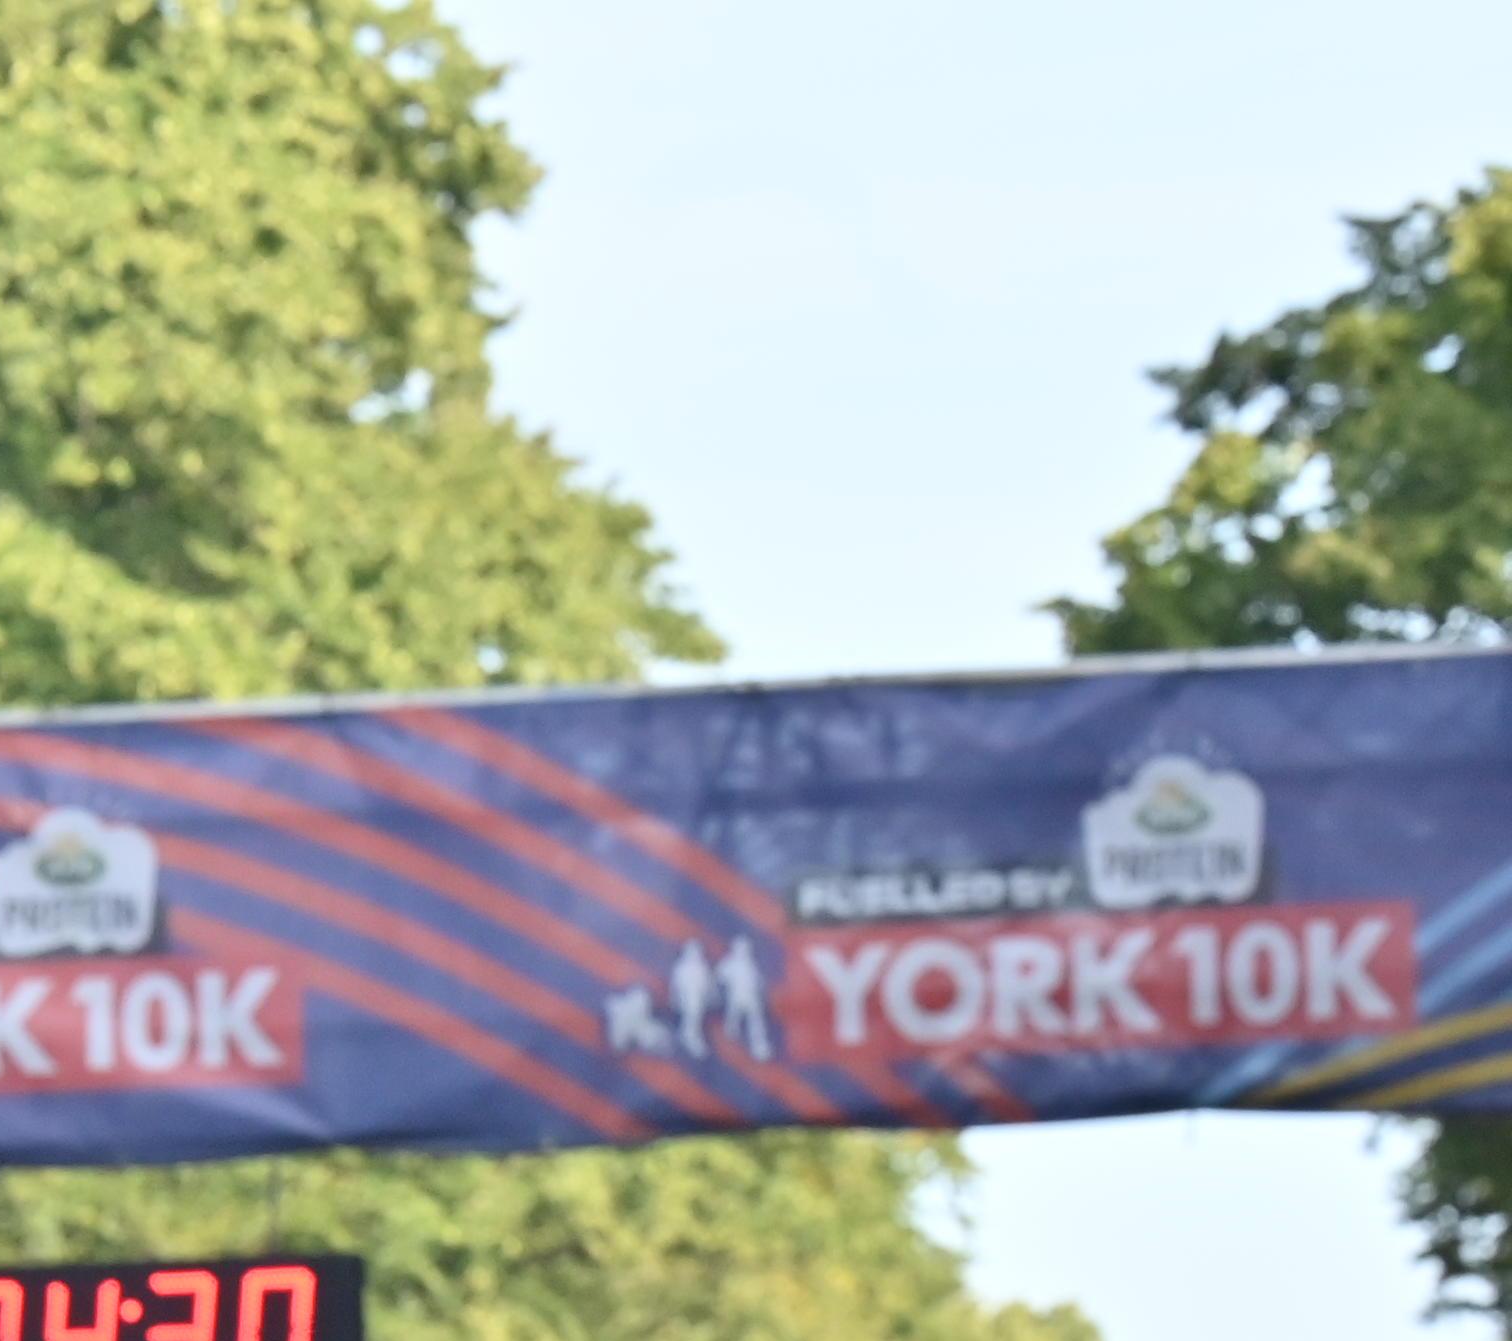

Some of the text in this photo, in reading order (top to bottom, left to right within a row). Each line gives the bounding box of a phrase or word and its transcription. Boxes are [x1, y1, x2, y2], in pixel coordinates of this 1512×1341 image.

[71, 966, 283, 1071] 10K
[805, 917, 1395, 1046] YORK 10K
